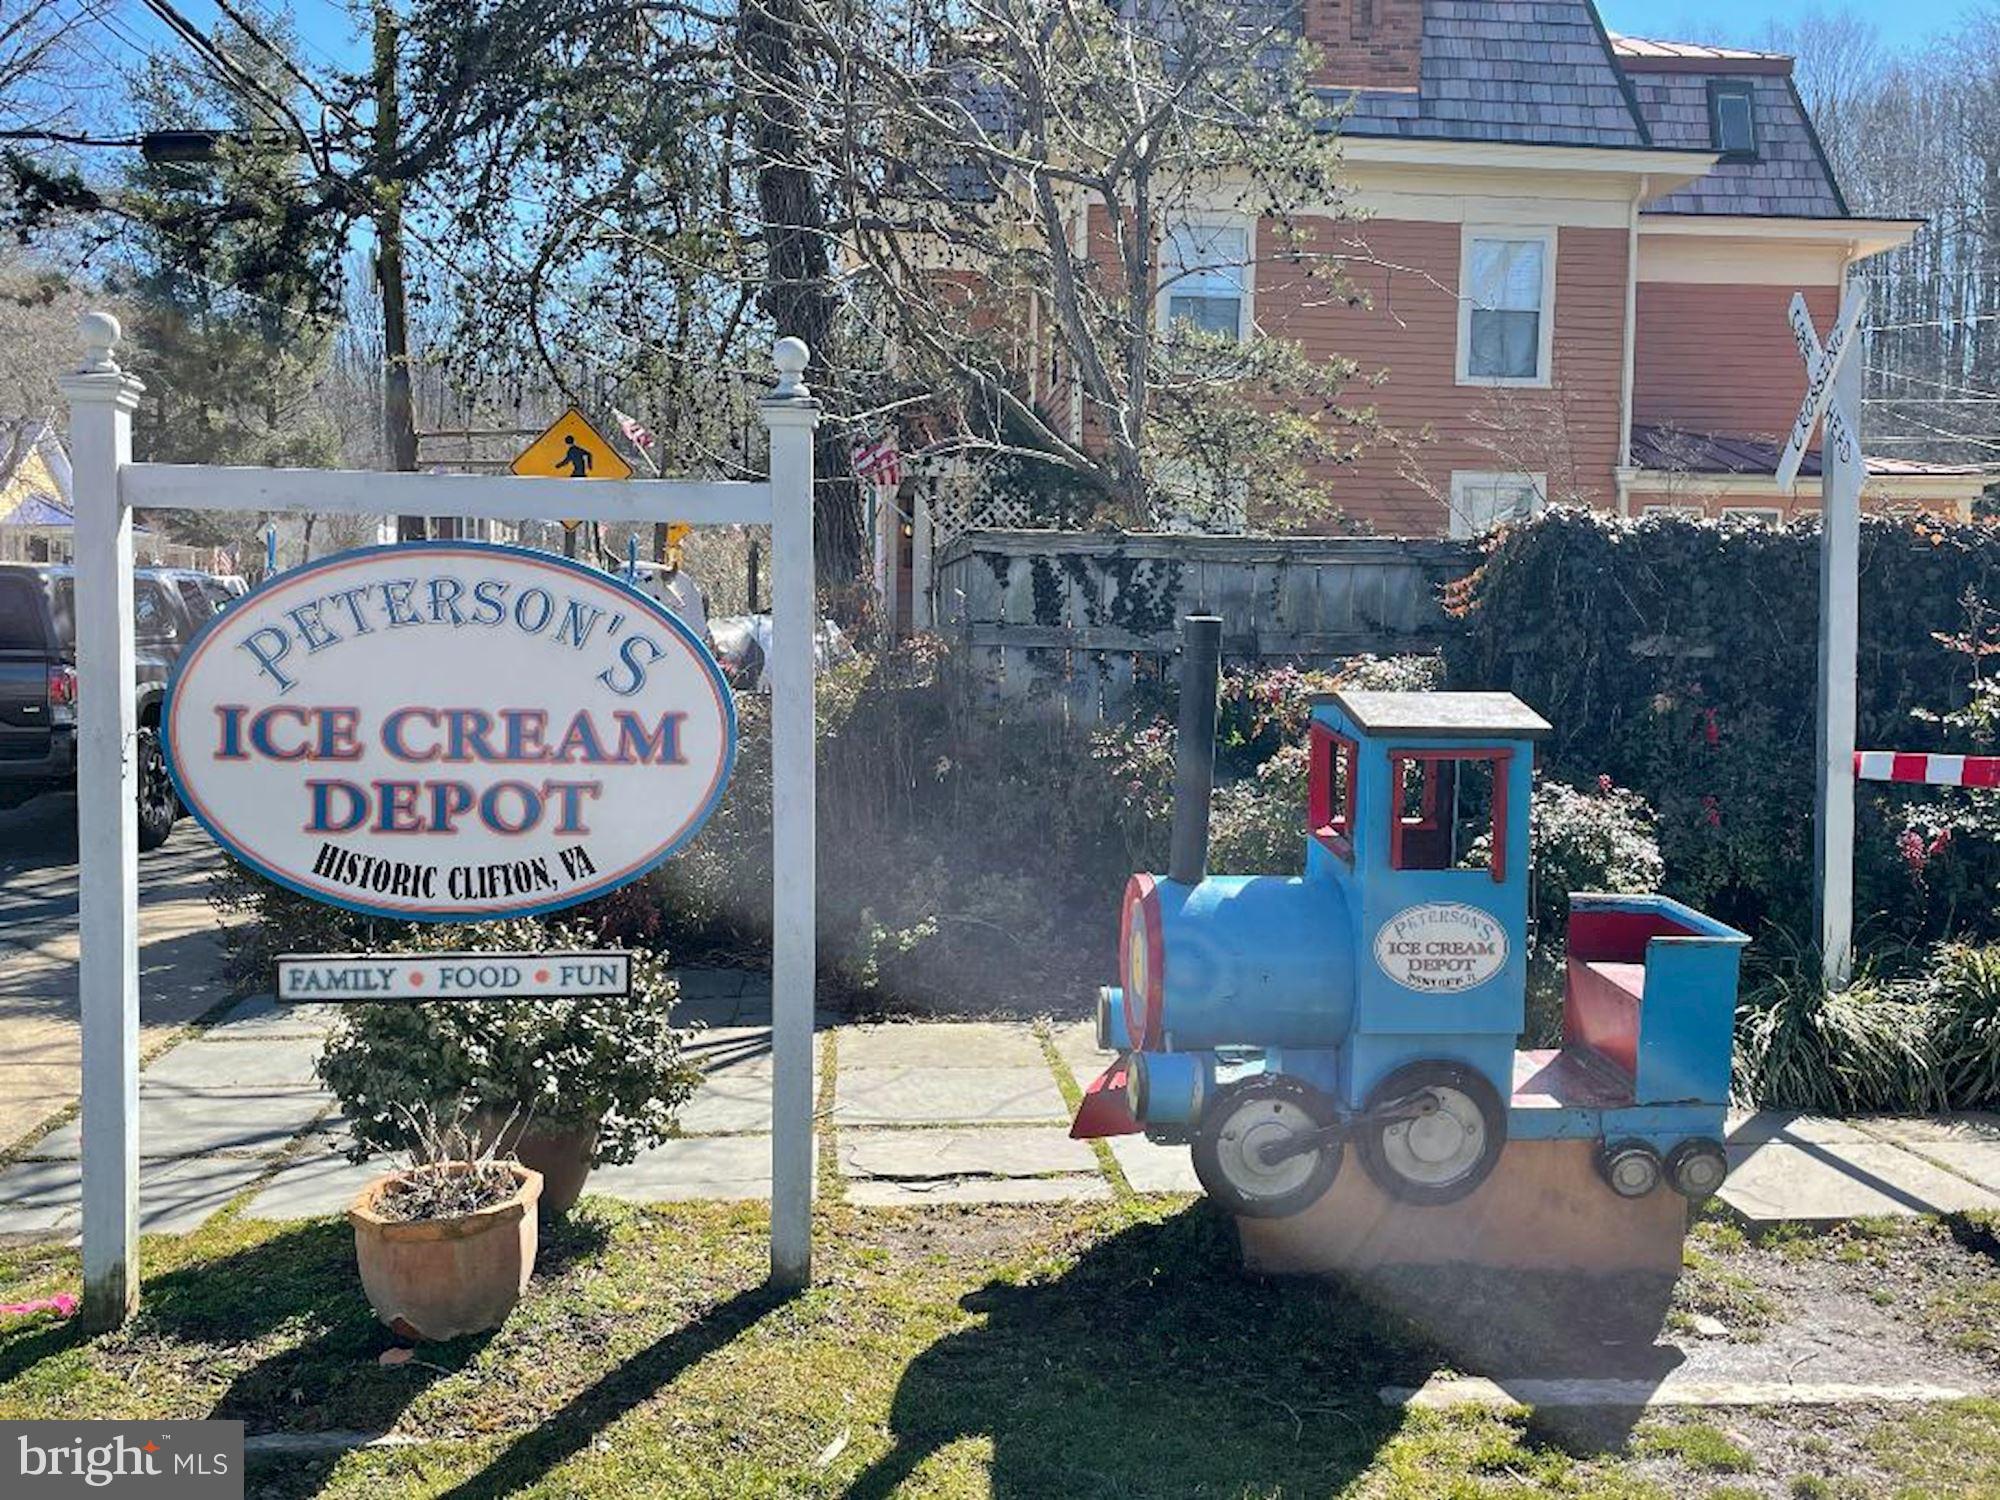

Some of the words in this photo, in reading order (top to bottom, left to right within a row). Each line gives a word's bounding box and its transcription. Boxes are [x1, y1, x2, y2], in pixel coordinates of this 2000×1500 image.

[1792, 325, 1844, 451] CROSSING
[237, 577, 667, 697] PETERSON'S
[213, 704, 363, 763] ICE
[380, 705, 689, 766] CREAM
[303, 778, 601, 836] DEPOT
[311, 842, 438, 899] HISTORIC
[448, 856, 558, 900] CLIFTON,
[559, 845, 597, 882] VA
[1388, 941, 1421, 956] ICE
[1426, 941, 1496, 956] CREAM
[1394, 909, 1495, 942] PETERSON'S
[288, 966, 397, 991] FAMILY
[438, 965, 521, 989] FOOD
[560, 964, 618, 987] FUN
[1407, 958, 1476, 972] DEPOT
